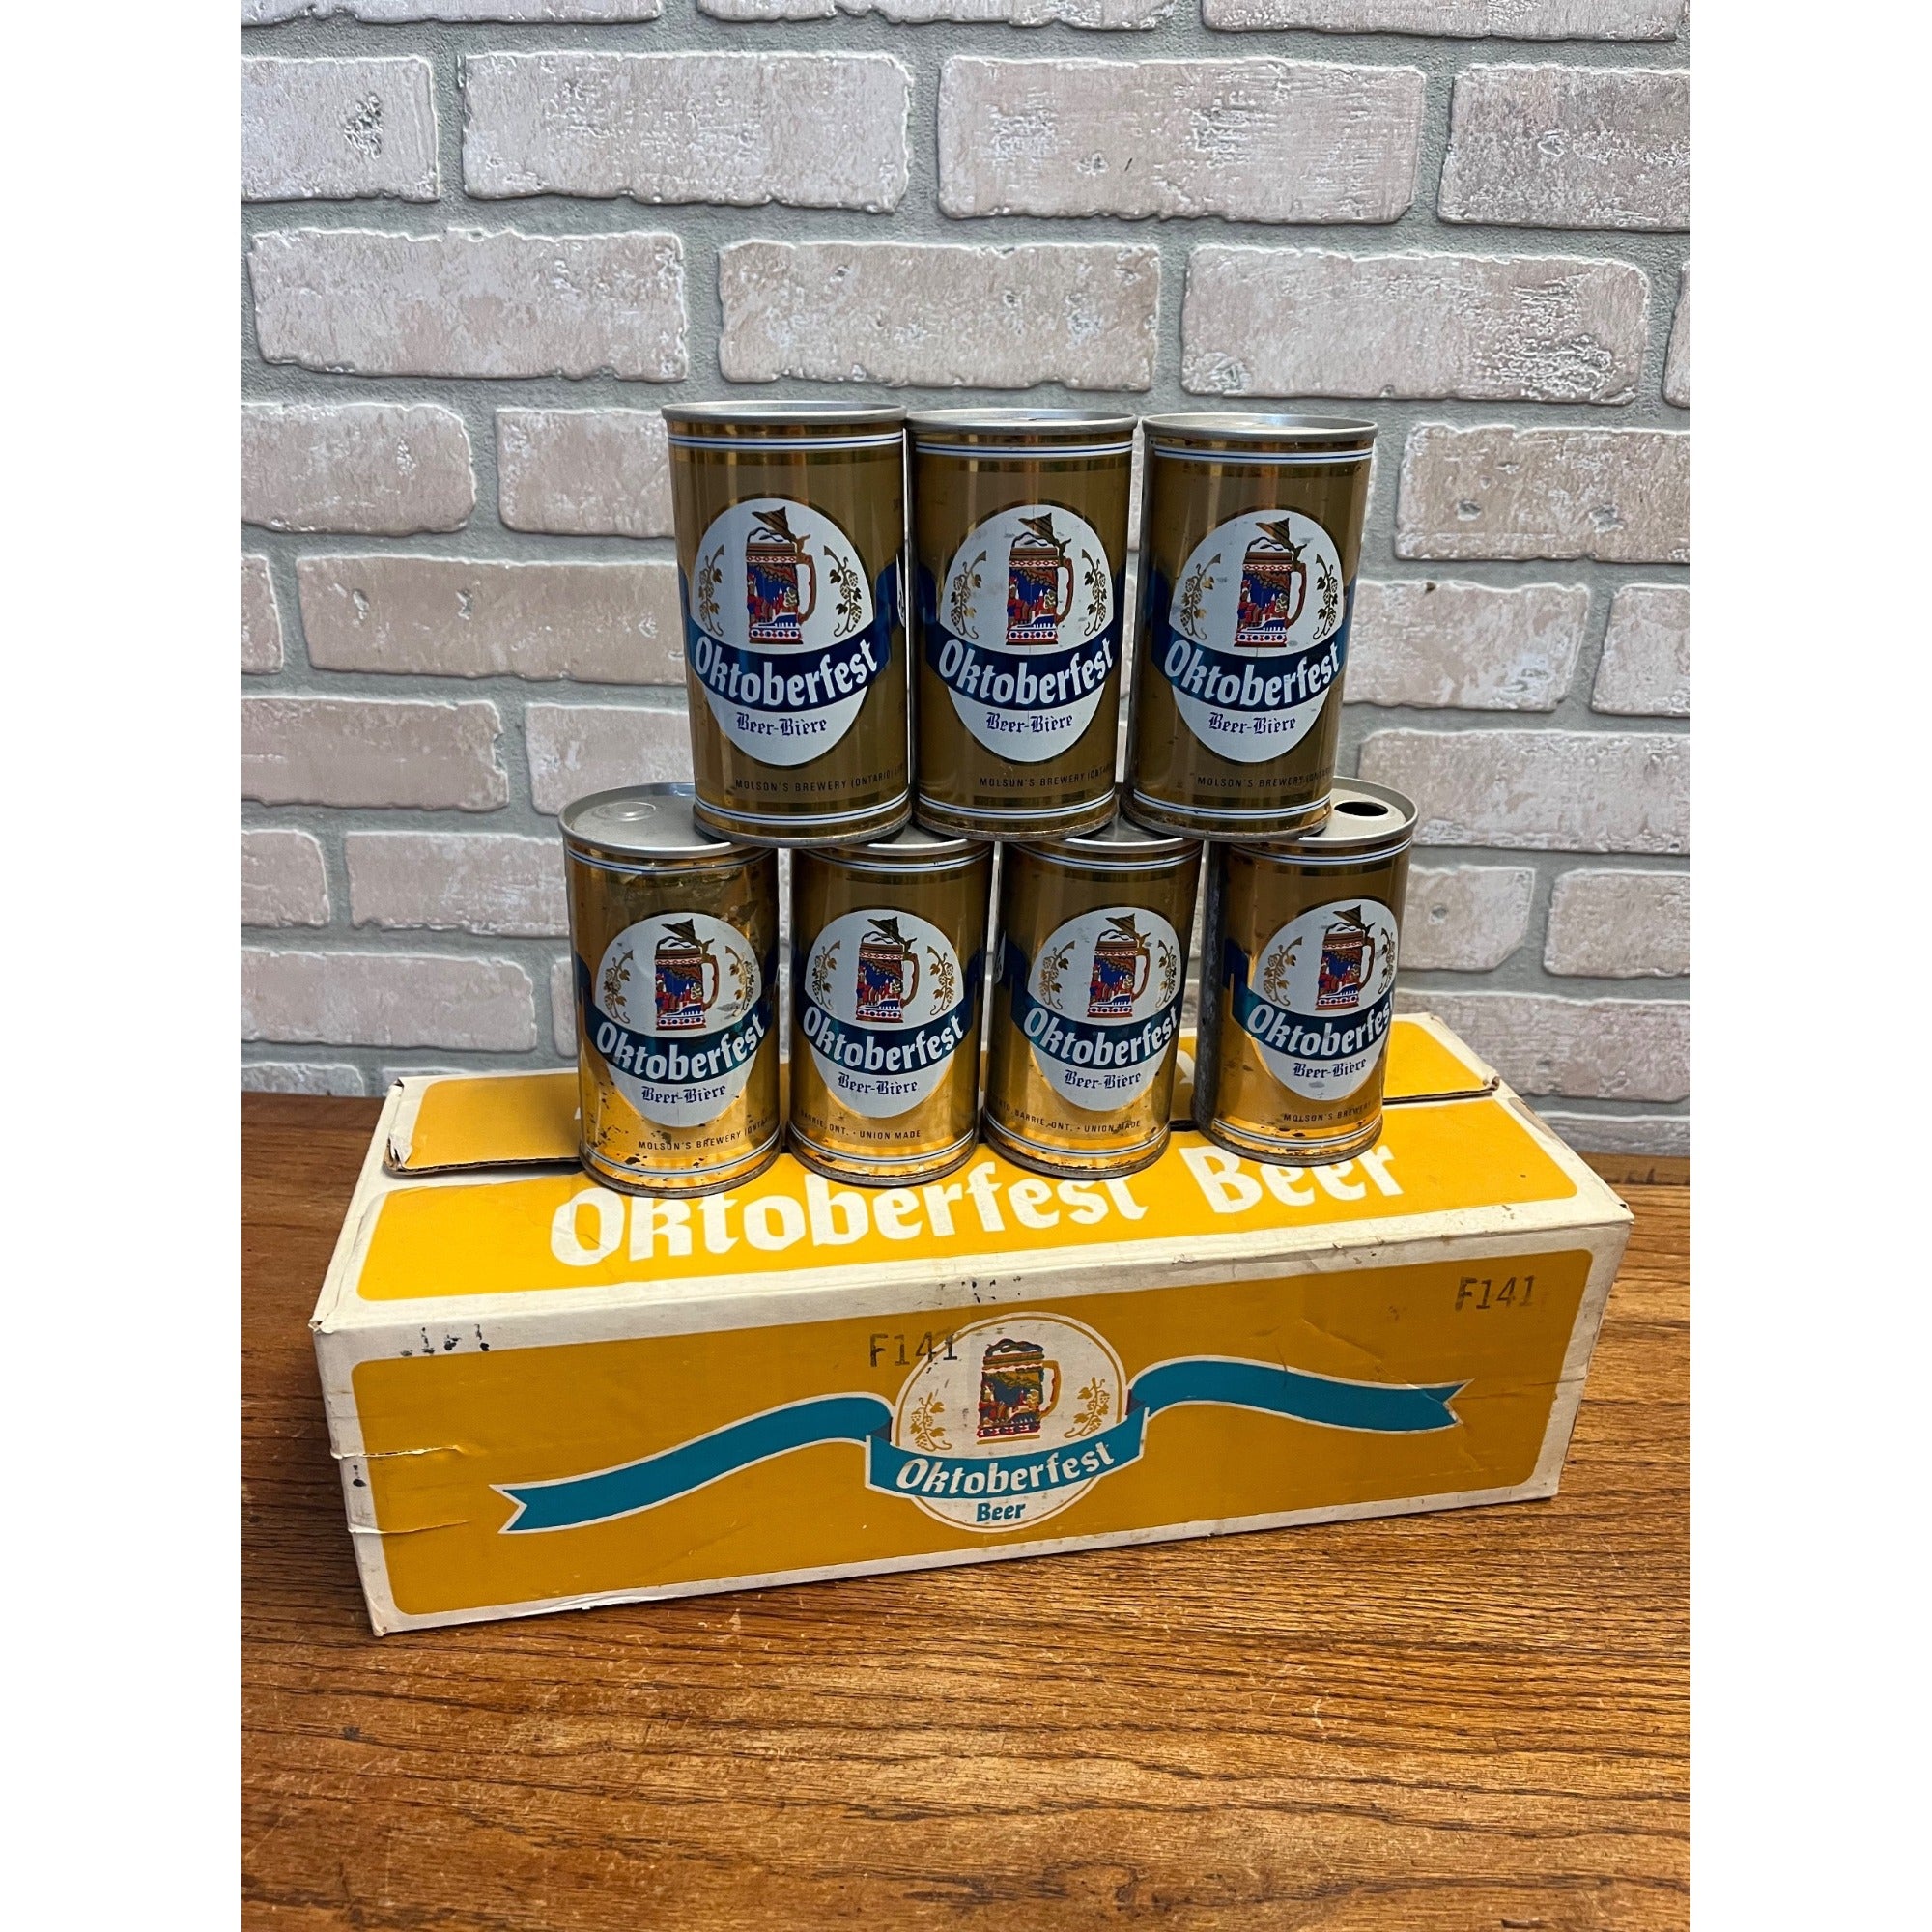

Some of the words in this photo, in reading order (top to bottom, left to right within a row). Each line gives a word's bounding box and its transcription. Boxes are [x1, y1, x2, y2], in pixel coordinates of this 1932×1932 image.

[696, 636, 877, 706] Oktoberfest
[939, 638, 1114, 705] Oktoberfest
[1164, 639, 1340, 706] Oktoberfest
[736, 711, 827, 736] Beer-Bière
[986, 711, 1072, 733] Beer-Bière
[1209, 712, 1295, 734] Beer-Bière
[735, 779, 789, 792] MOLSON'S
[795, 781, 847, 791] BREWERY
[1040, 774, 1085, 786] BREWERY
[1197, 777, 1253, 788] MOLSON'S
[803, 1006, 963, 1071] Oktoberfest
[1023, 1005, 1178, 1065] Oktoberfest
[596, 1013, 765, 1080] Oktoberfest
[1065, 1069, 1141, 1089] Beer-Bière
[1293, 1058, 1366, 1078] Beer-Bière
[838, 1071, 918, 1095] Beer-Bière
[641, 1085, 726, 1104] Beer-Bière
[1051, 1121, 1073, 1133] ONT.
[1084, 1124, 1114, 1134] UNION
[1118, 1120, 1141, 1132] MADE
[1283, 1112, 1333, 1122] MOLSON'S
[639, 1141, 691, 1151] MOLSON'S
[696, 1133, 741, 1149] BREWERY
[829, 1123, 850, 1137] ONT.
[859, 1130, 891, 1140] UNION
[895, 1129, 921, 1139] MADE
[551, 1161, 1148, 1266] Oktoberfest
[1178, 1144, 1404, 1213] Beer
[1454, 1275, 1535, 1312] F141
[869, 1330, 958, 1368] F141
[895, 1441, 1114, 1495] Oktoberfest
[976, 1502, 1026, 1522] Beer
